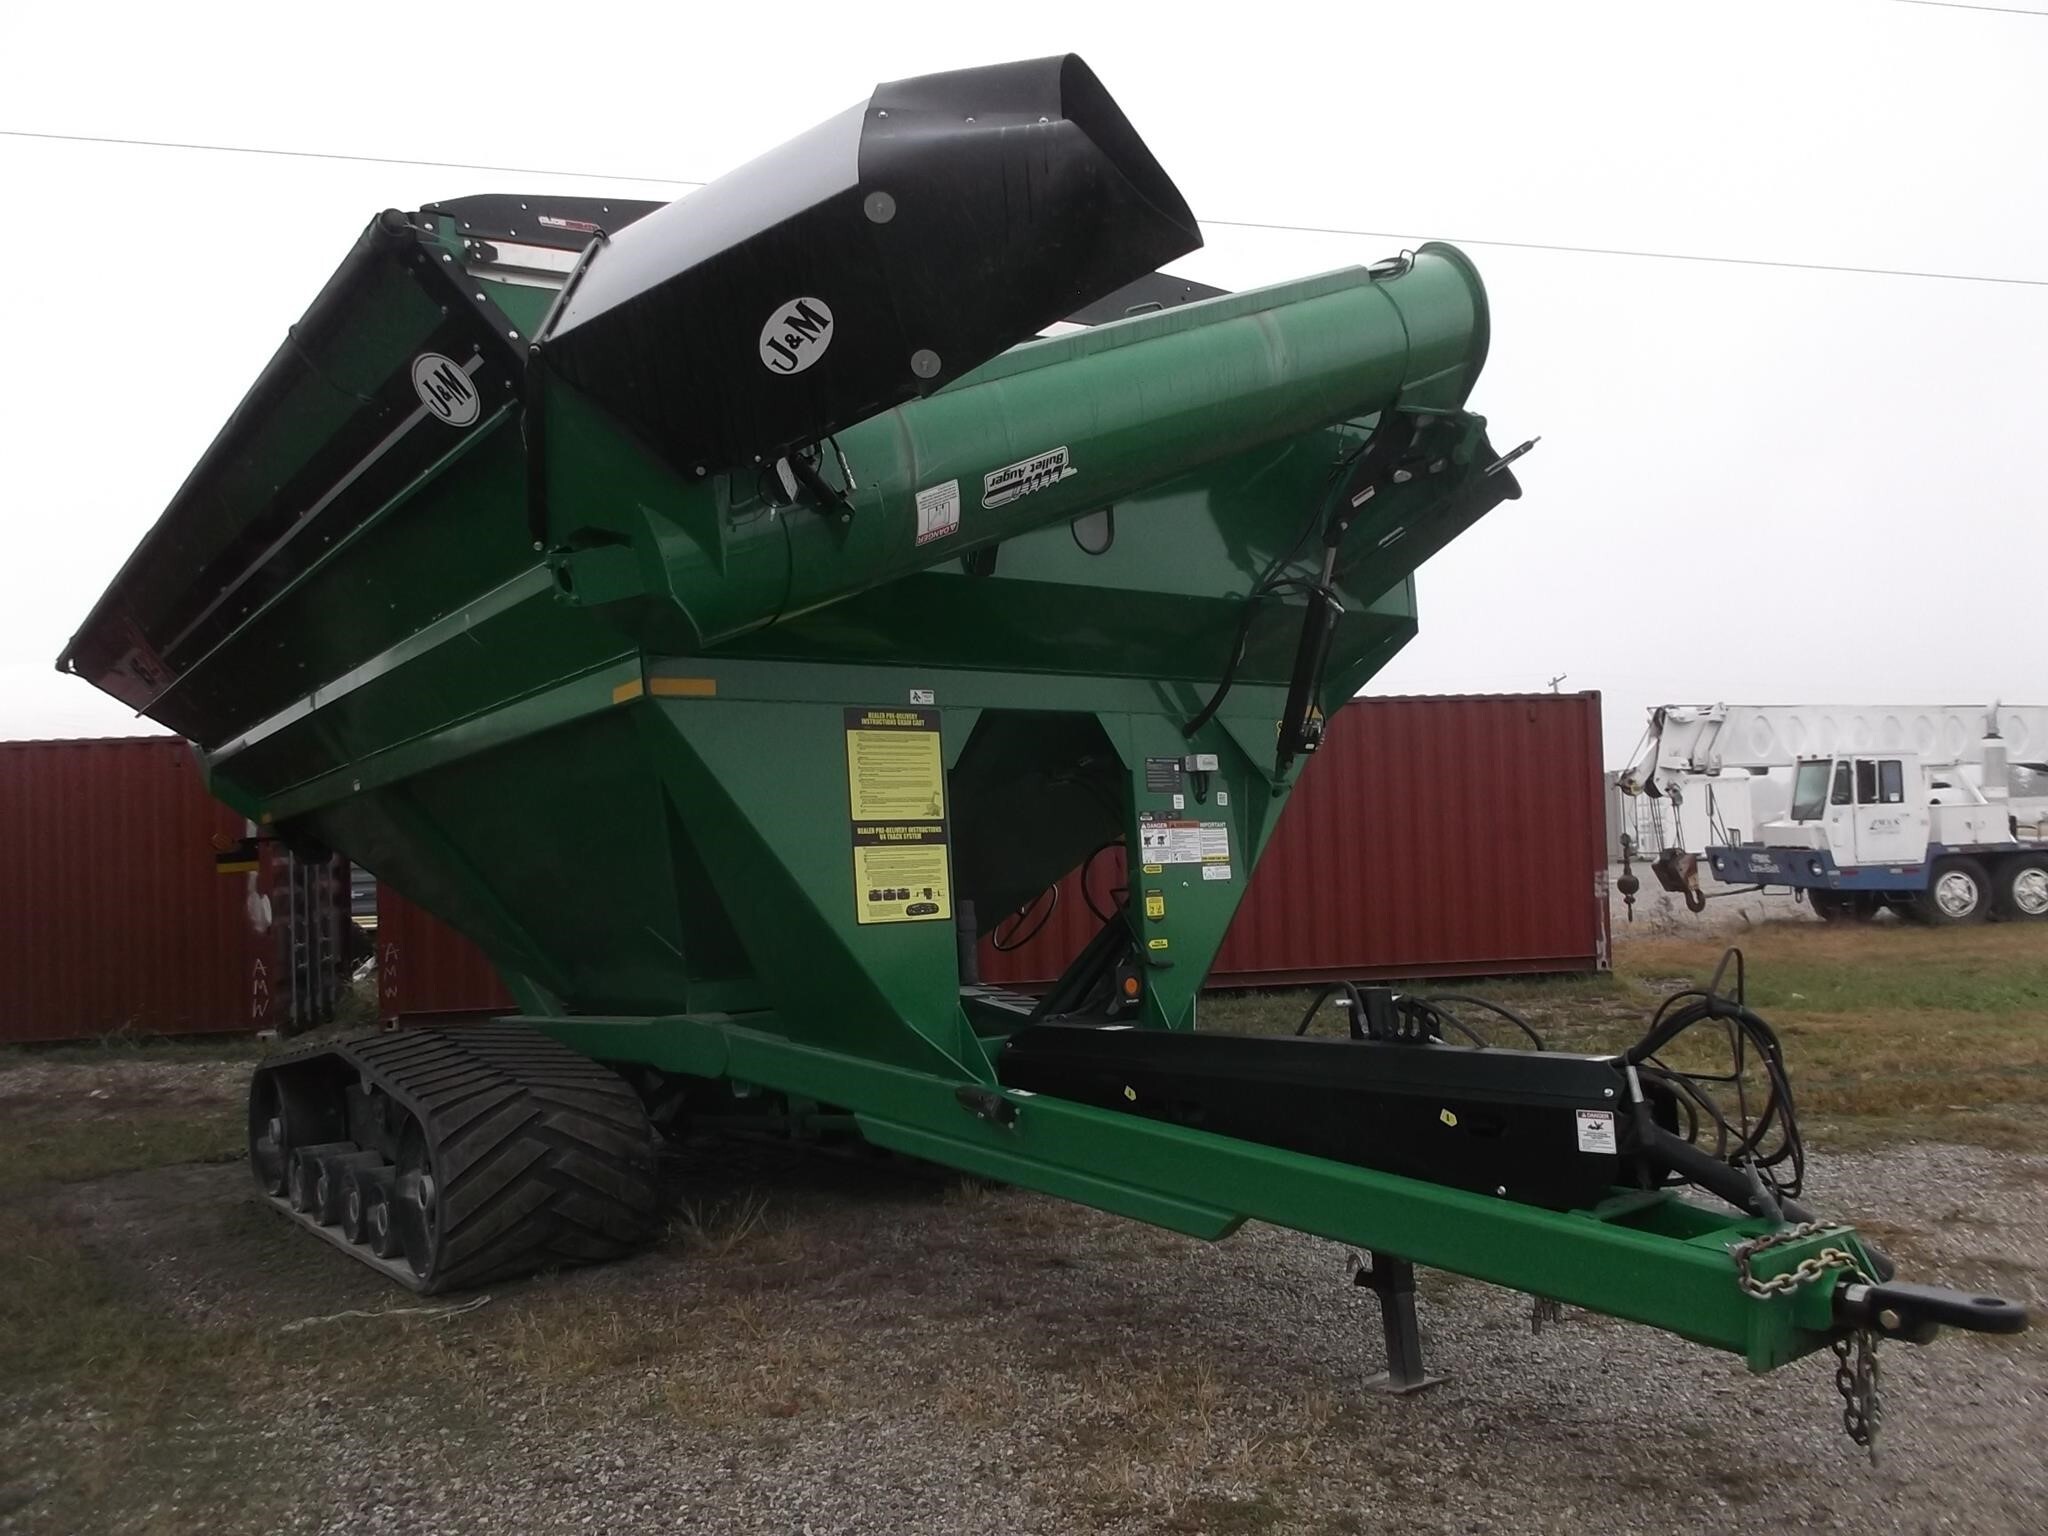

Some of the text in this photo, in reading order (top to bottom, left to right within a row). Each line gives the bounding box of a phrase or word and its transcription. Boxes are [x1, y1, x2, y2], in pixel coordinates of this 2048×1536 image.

[766, 300, 831, 371] J&M
[422, 362, 473, 417] J&M
[990, 453, 1064, 487] Bullet Auger
[918, 526, 950, 544] DANGER
